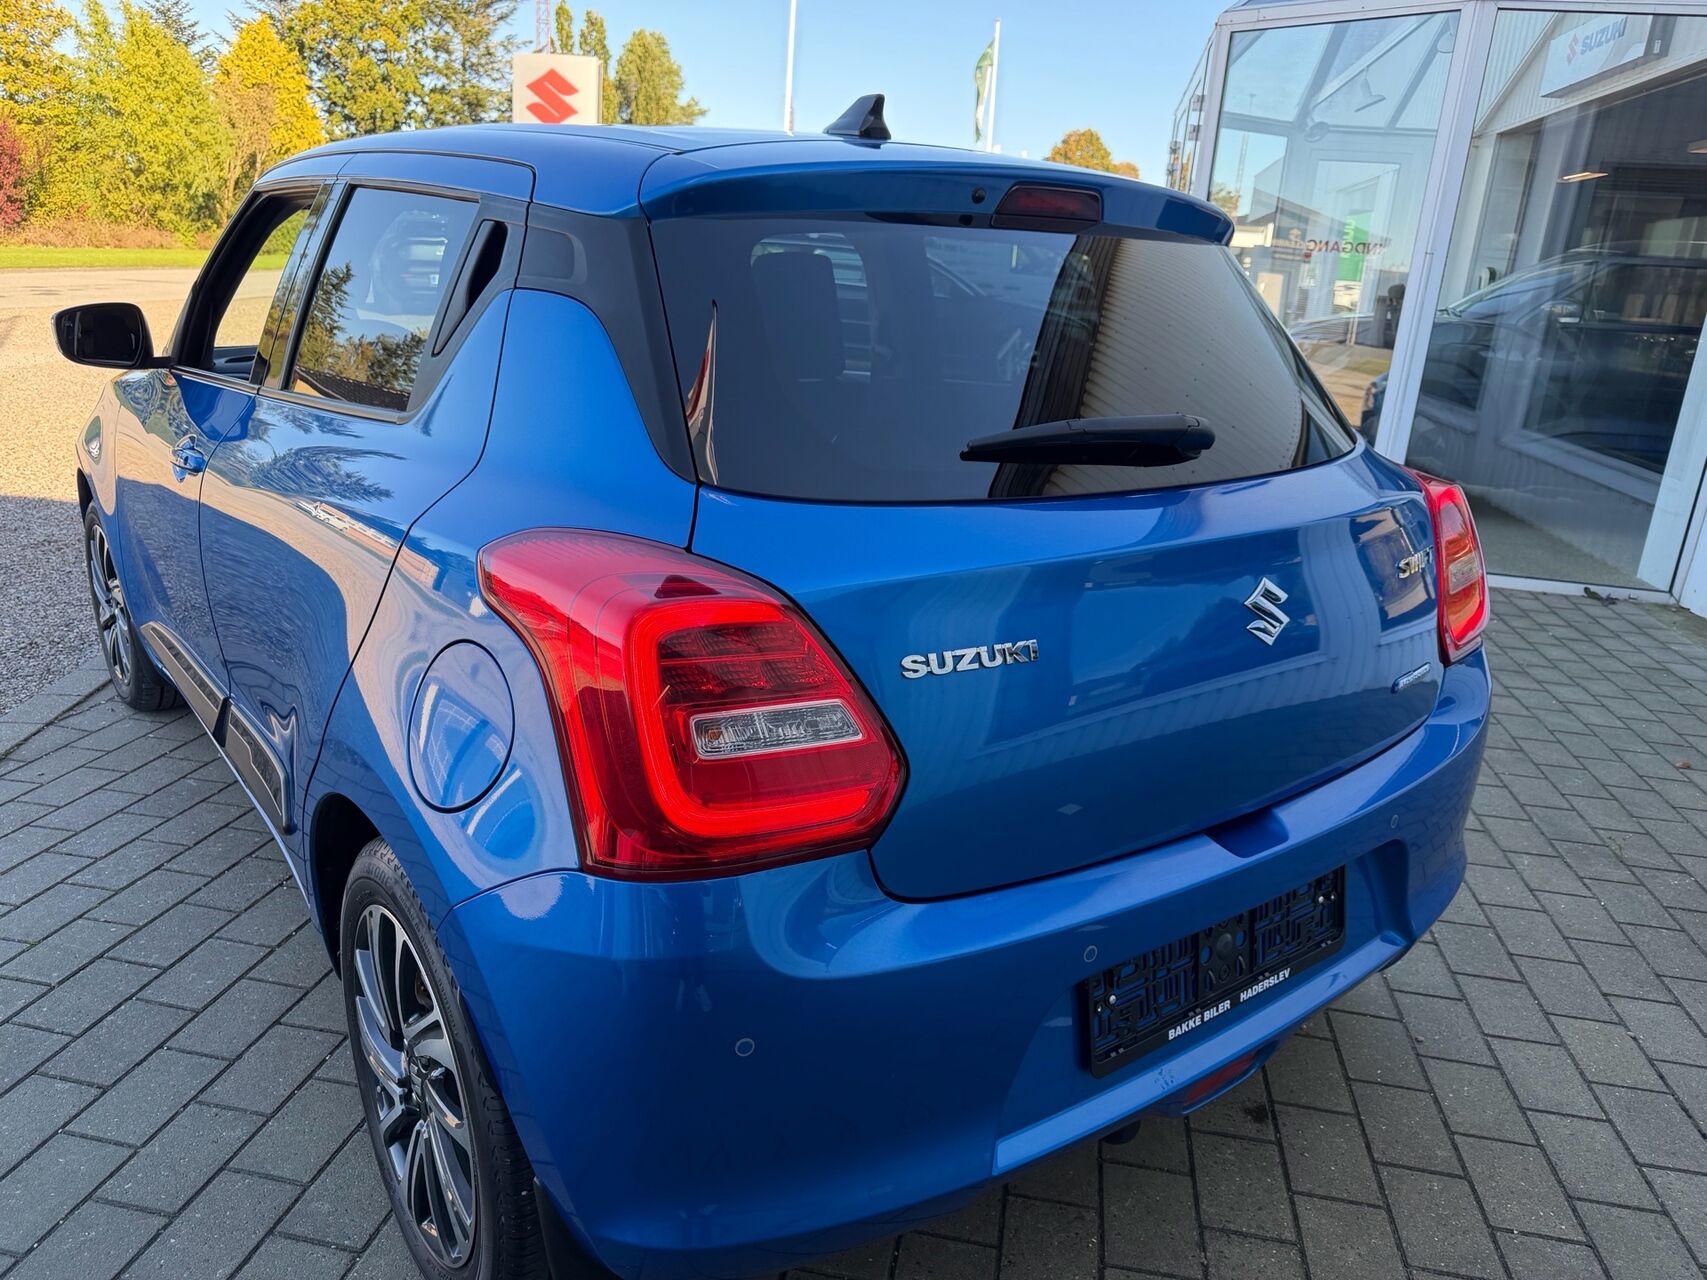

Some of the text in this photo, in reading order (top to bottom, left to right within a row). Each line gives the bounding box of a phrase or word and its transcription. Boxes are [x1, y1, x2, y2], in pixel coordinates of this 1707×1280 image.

[901, 639, 1040, 679] SUZUKI
[1168, 968, 1291, 1041] BAKKE BILER HADERSLEV
